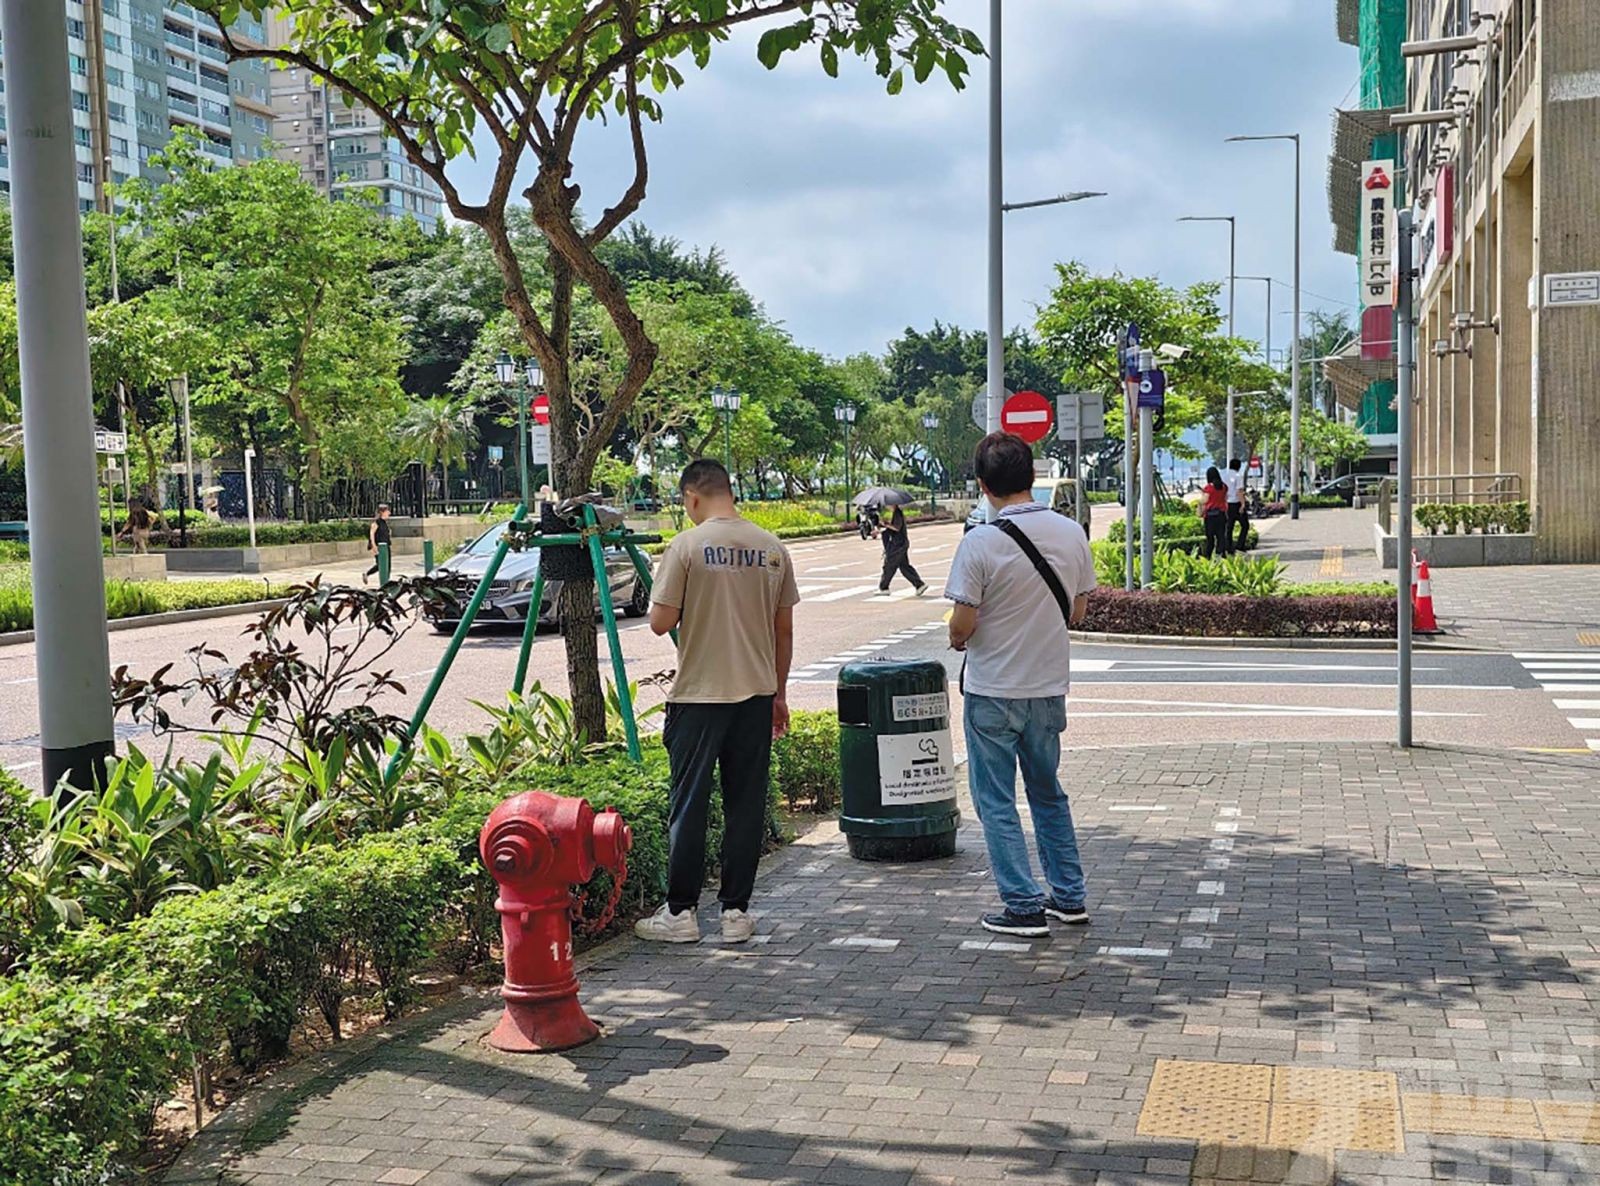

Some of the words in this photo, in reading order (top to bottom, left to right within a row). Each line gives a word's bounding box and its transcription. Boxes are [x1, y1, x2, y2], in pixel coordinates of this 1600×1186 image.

[1370, 197, 1385, 255] 廣發銀行
[704, 546, 767, 567] ACTIVE
[549, 941, 573, 961] 12
